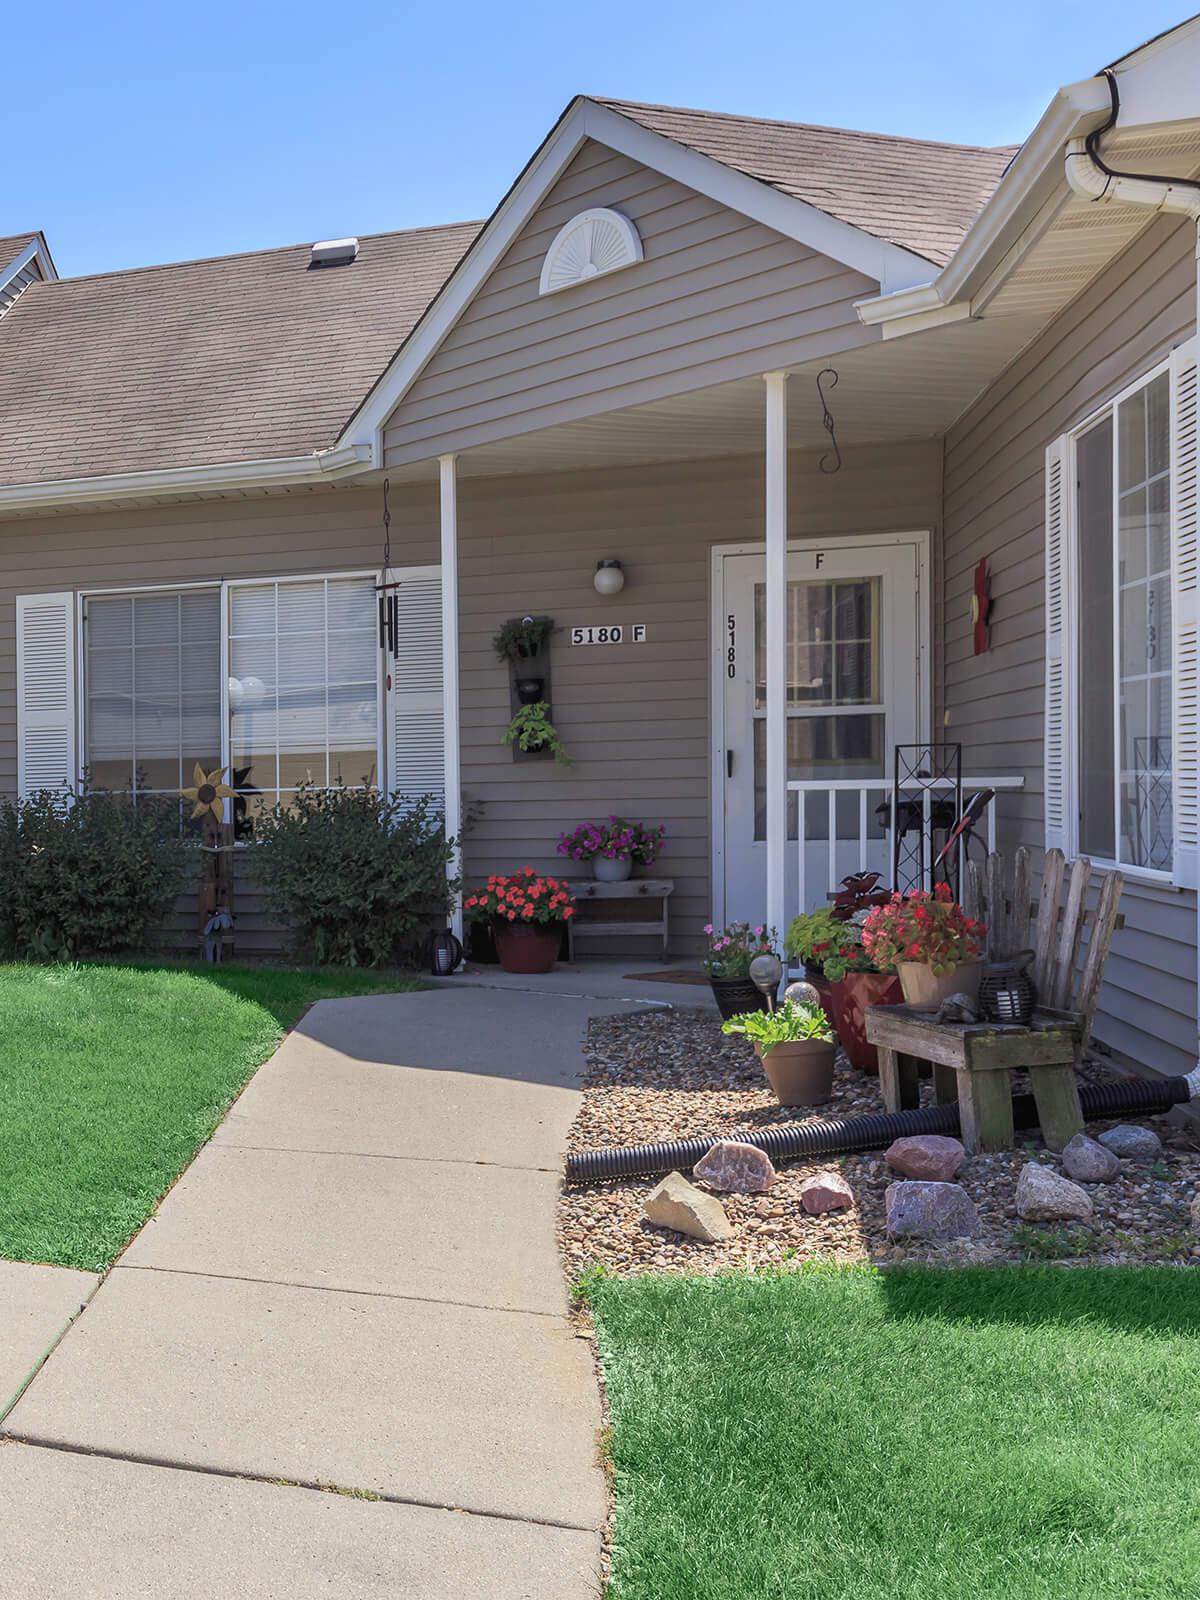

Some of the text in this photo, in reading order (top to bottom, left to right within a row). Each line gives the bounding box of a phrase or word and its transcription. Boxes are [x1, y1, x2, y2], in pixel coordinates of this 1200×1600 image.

[815, 553, 825, 569] F
[573, 626, 645, 644] 5180 F
[728, 615, 736, 679] 5180
